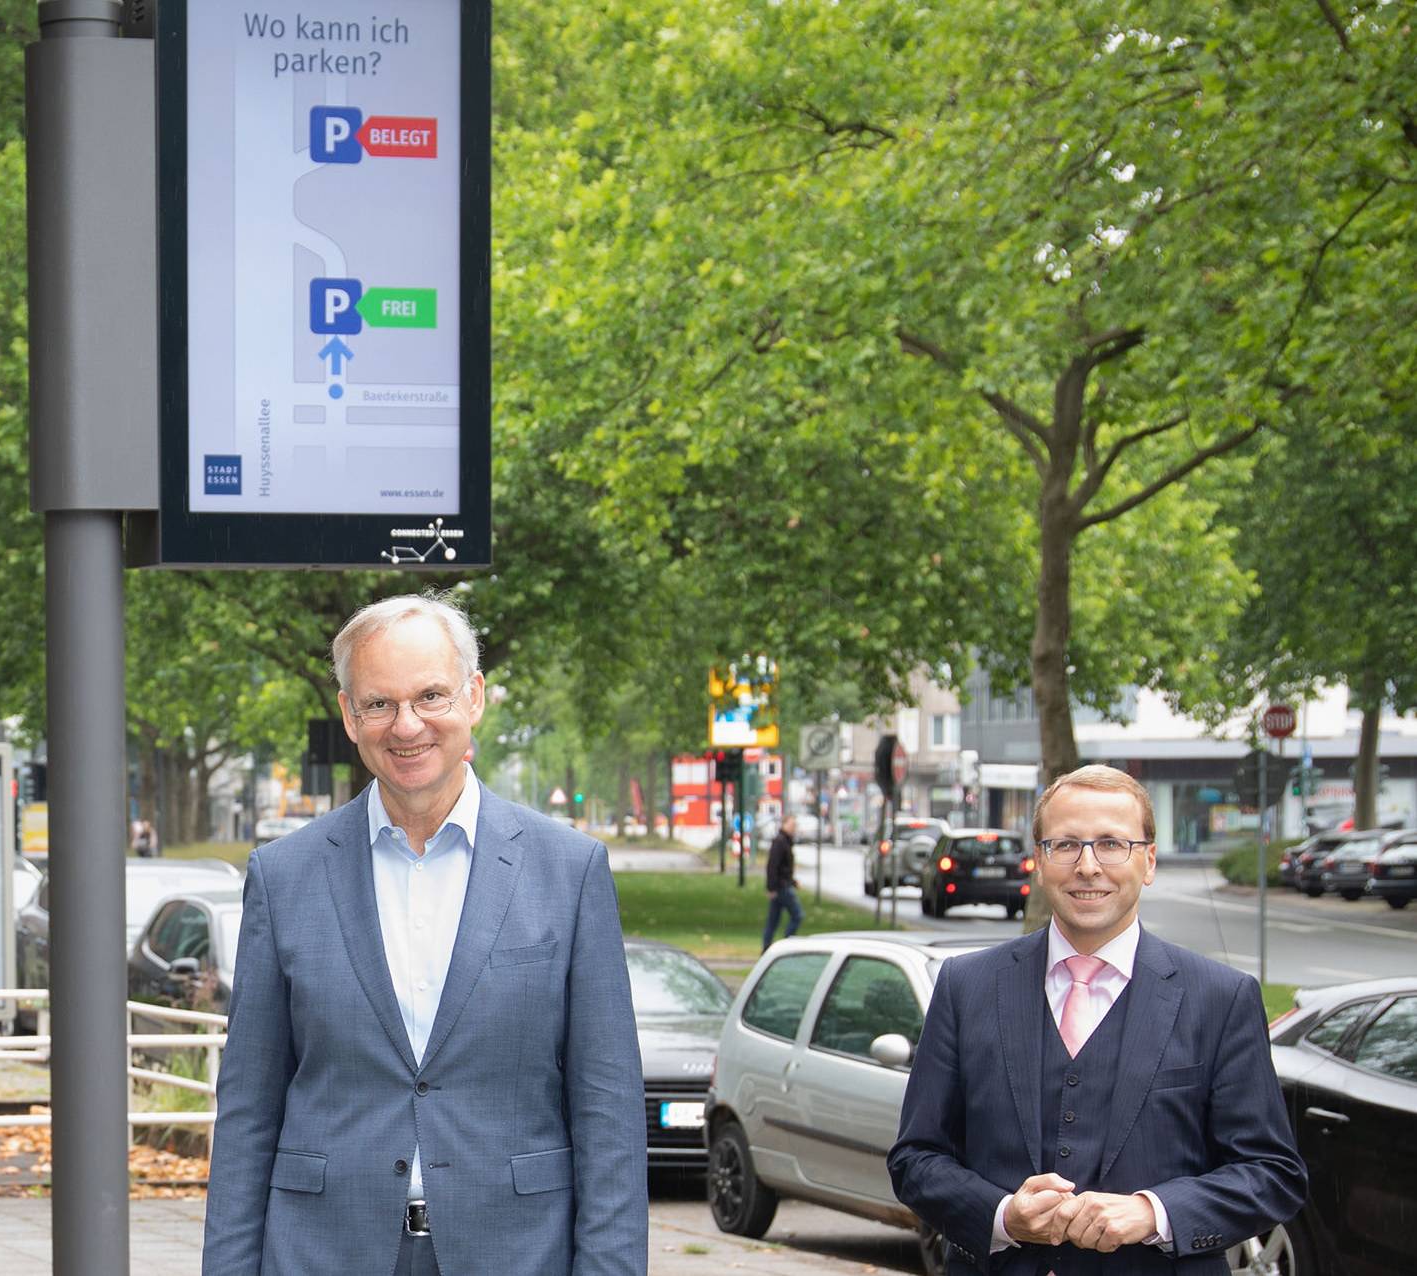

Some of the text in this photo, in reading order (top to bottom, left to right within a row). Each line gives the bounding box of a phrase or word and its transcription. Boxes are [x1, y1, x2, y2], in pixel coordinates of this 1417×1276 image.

[244, 13, 409, 43] Wo kann ich
[274, 48, 382, 77] parken?
[325, 116, 350, 153] P
[369, 128, 431, 147] BELEGT
[325, 288, 350, 324] P
[381, 299, 417, 317] FREI
[363, 390, 449, 403] Baedekerstraße
[258, 398, 274, 497] Huyssenallee
[206, 465, 238, 474] STADT
[206, 476, 238, 484] ESSEN
[379, 487, 445, 499] www.essen.de
